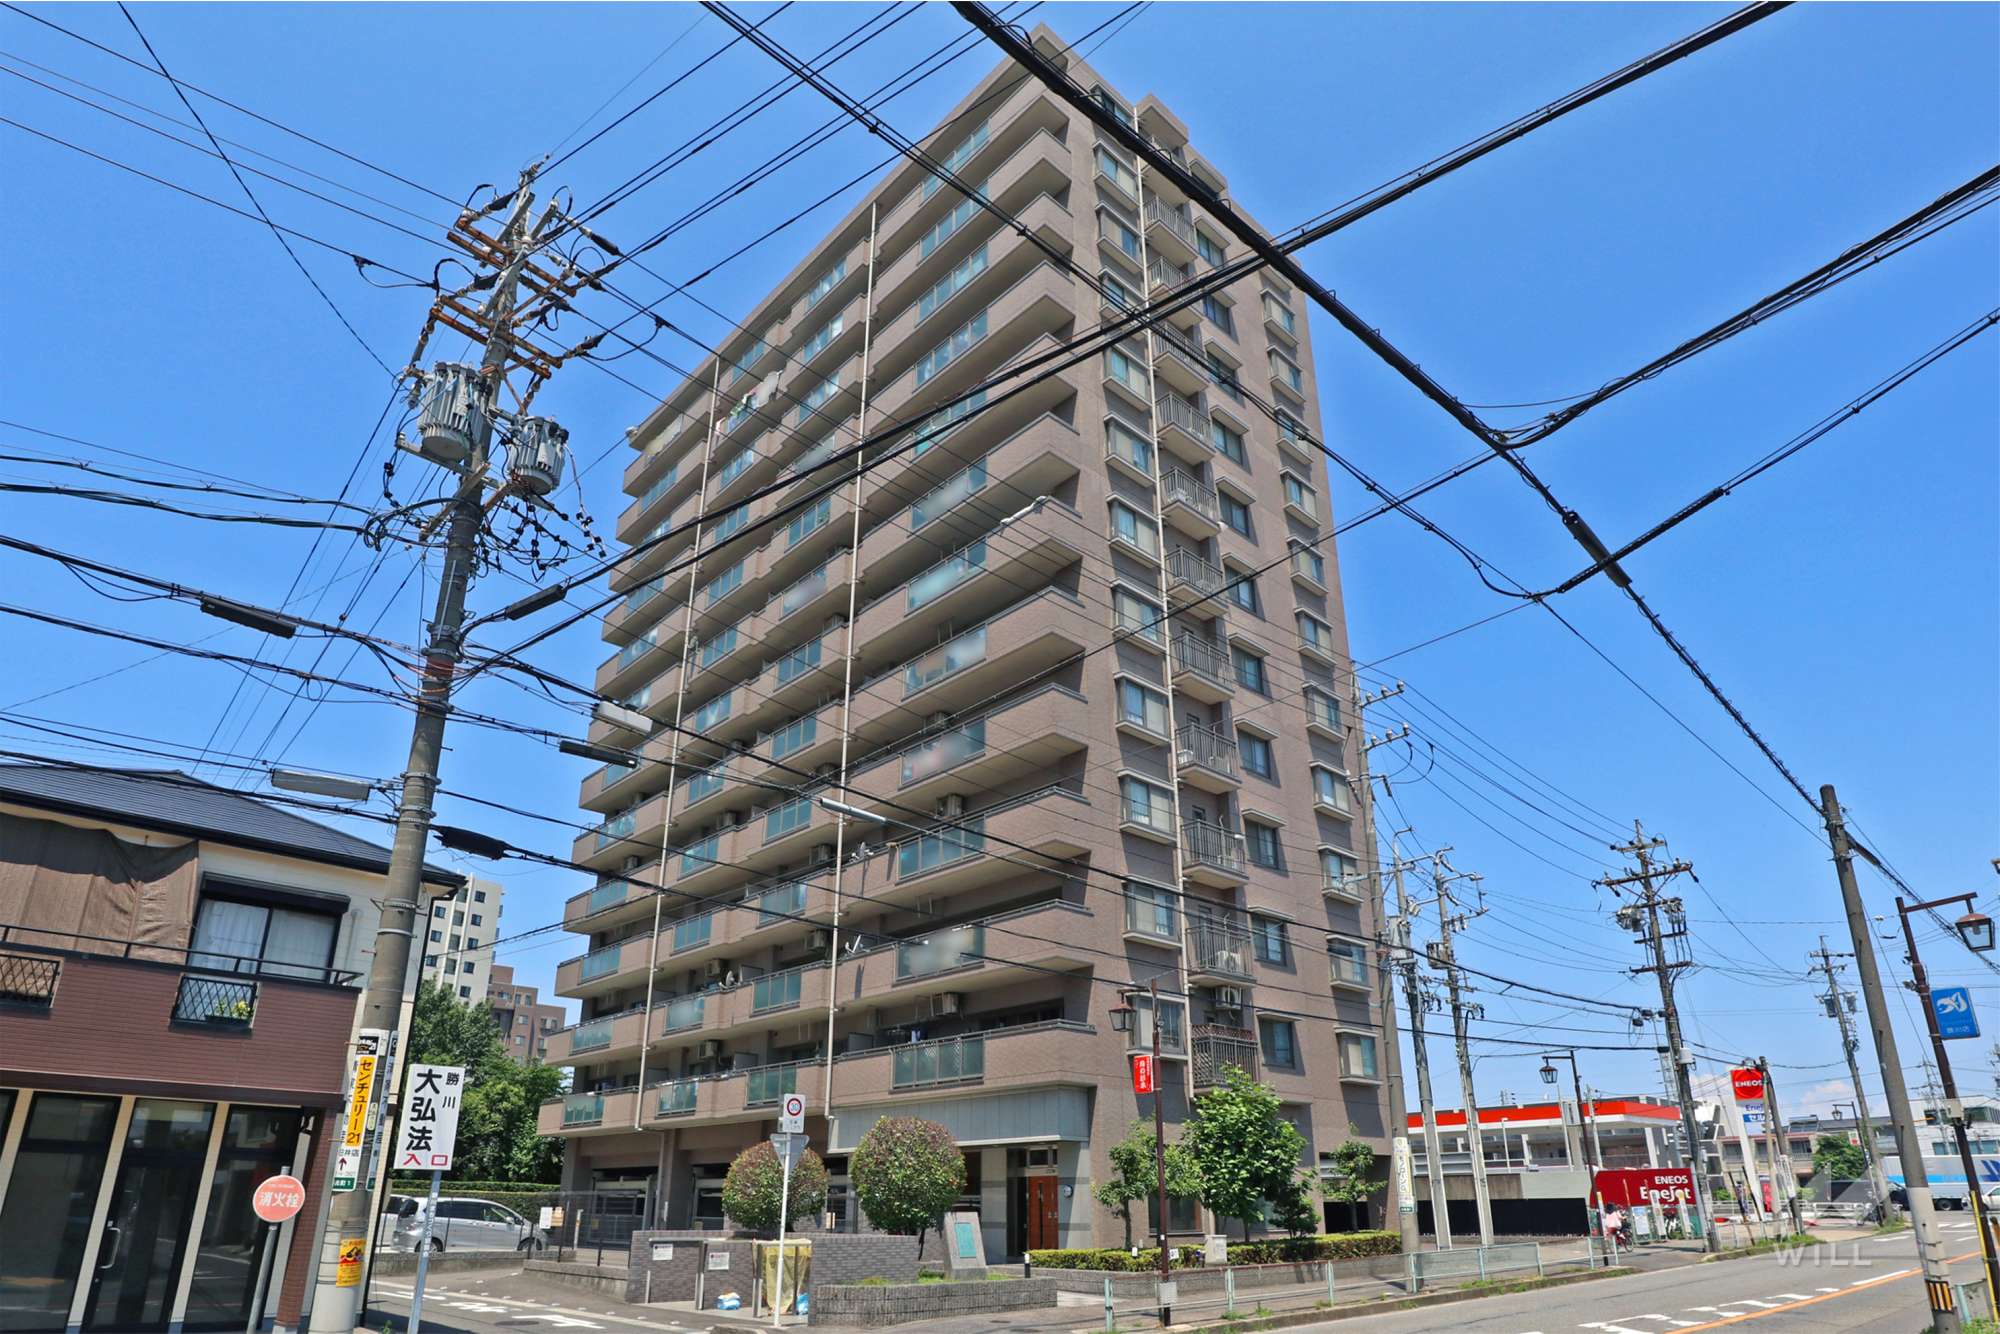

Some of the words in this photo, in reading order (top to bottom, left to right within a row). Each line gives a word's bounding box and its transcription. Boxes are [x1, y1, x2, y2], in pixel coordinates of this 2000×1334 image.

[346, 1059, 372, 1144] センチュリー21
[442, 1072, 459, 1109] 勝川
[405, 1068, 442, 1152] 大弘法
[403, 1152, 448, 1166] 入口
[1654, 1175, 1689, 1185] ENEOS
[258, 1191, 299, 1208] 消火栓
